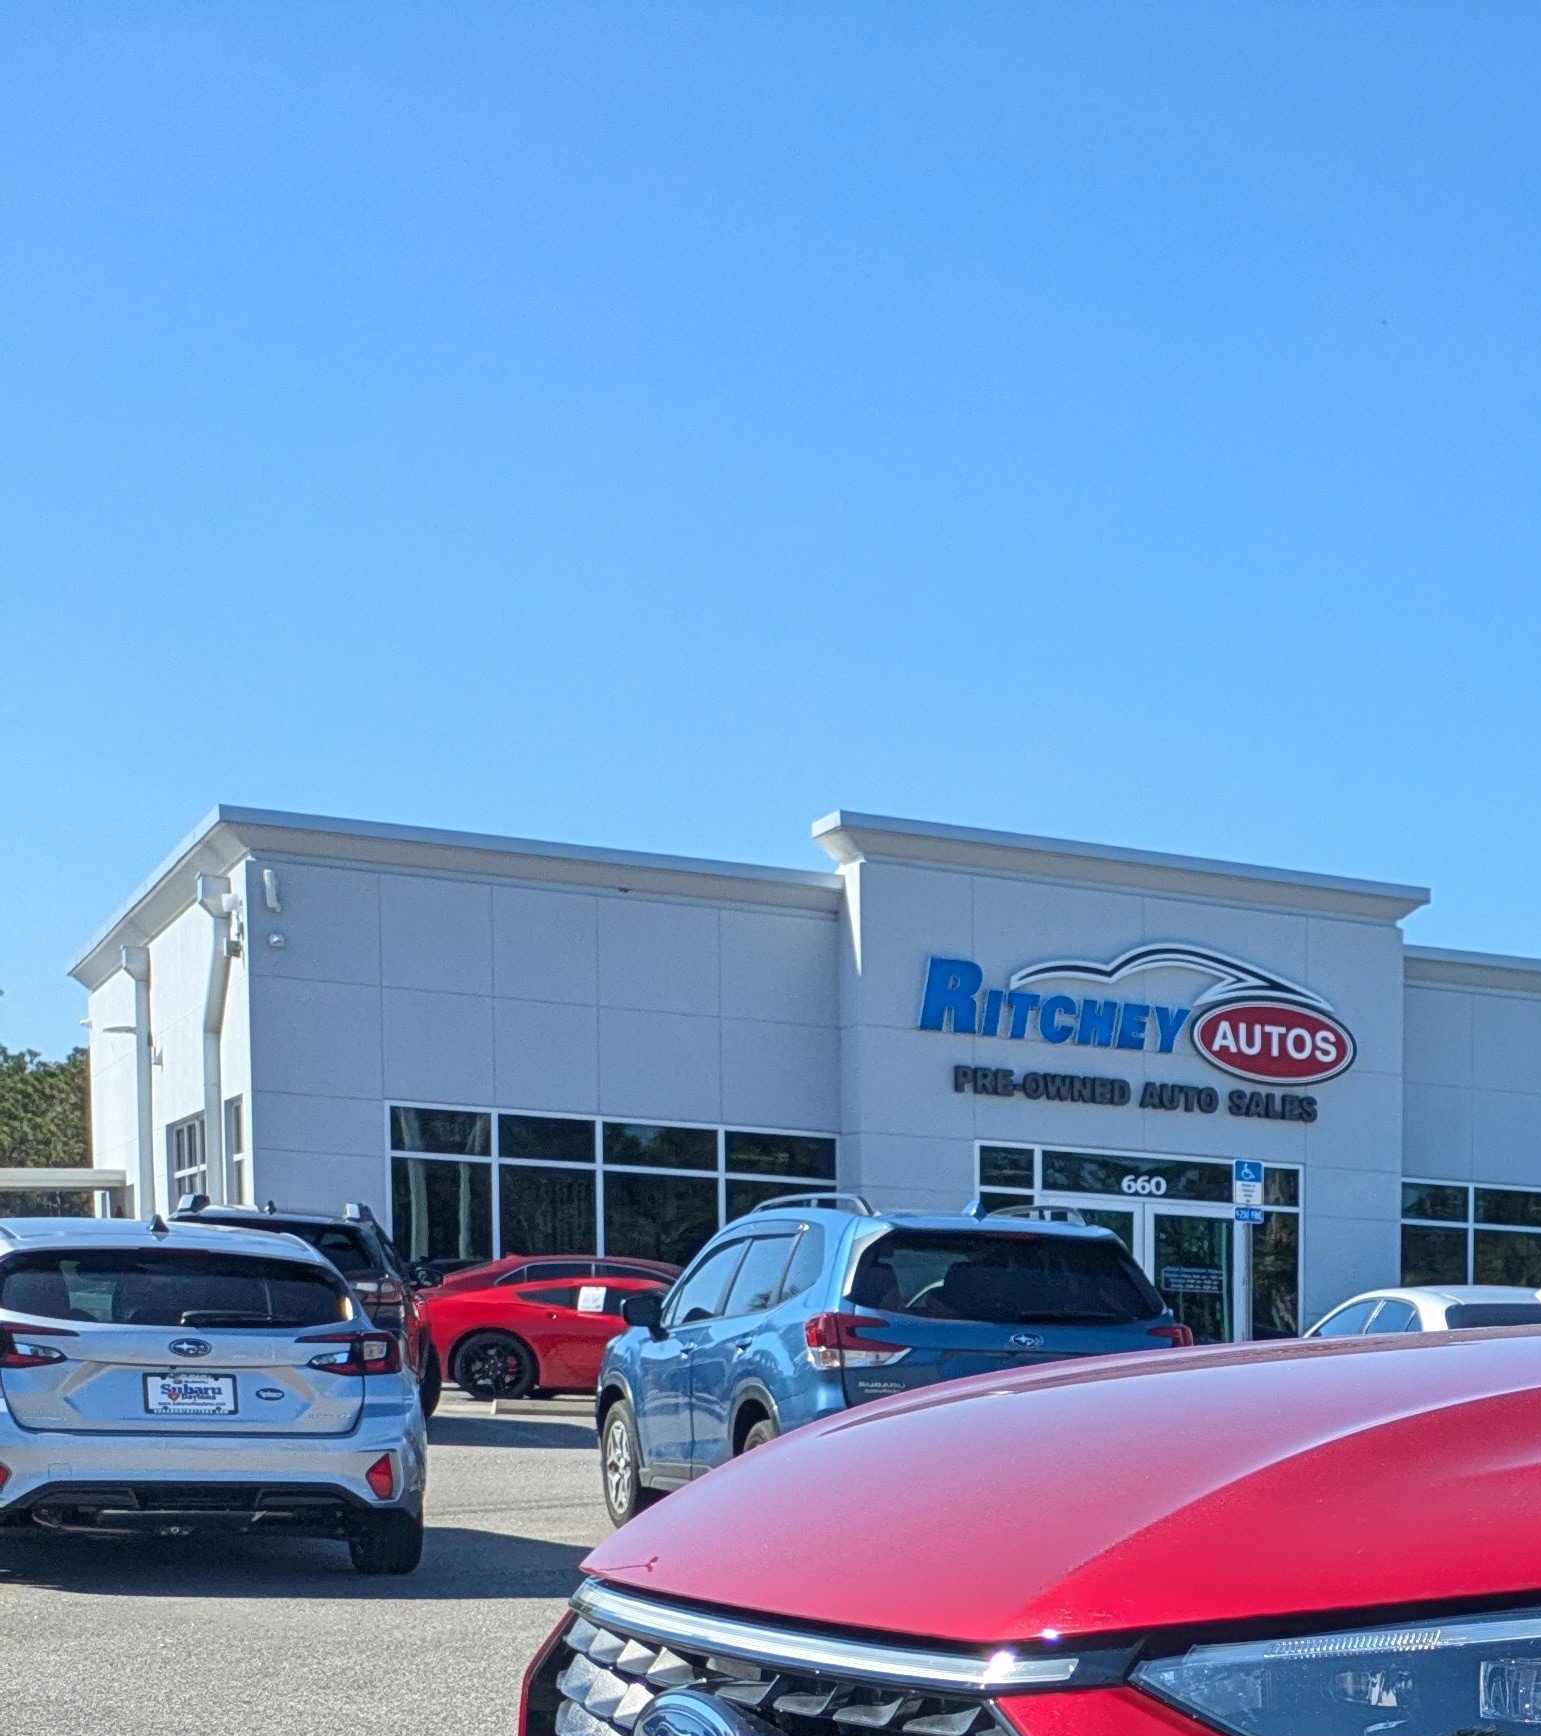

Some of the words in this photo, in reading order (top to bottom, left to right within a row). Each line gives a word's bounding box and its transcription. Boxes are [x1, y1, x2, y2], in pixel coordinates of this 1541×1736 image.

[1211, 1021, 1338, 1063] AUTOS
[953, 1064, 1132, 1107] PRE-OWNED
[1139, 1081, 1219, 1114] AUTO
[1227, 1090, 1318, 1124] SALES
[1121, 1174, 1167, 1196] 660
[160, 1384, 223, 1396] Subaru
